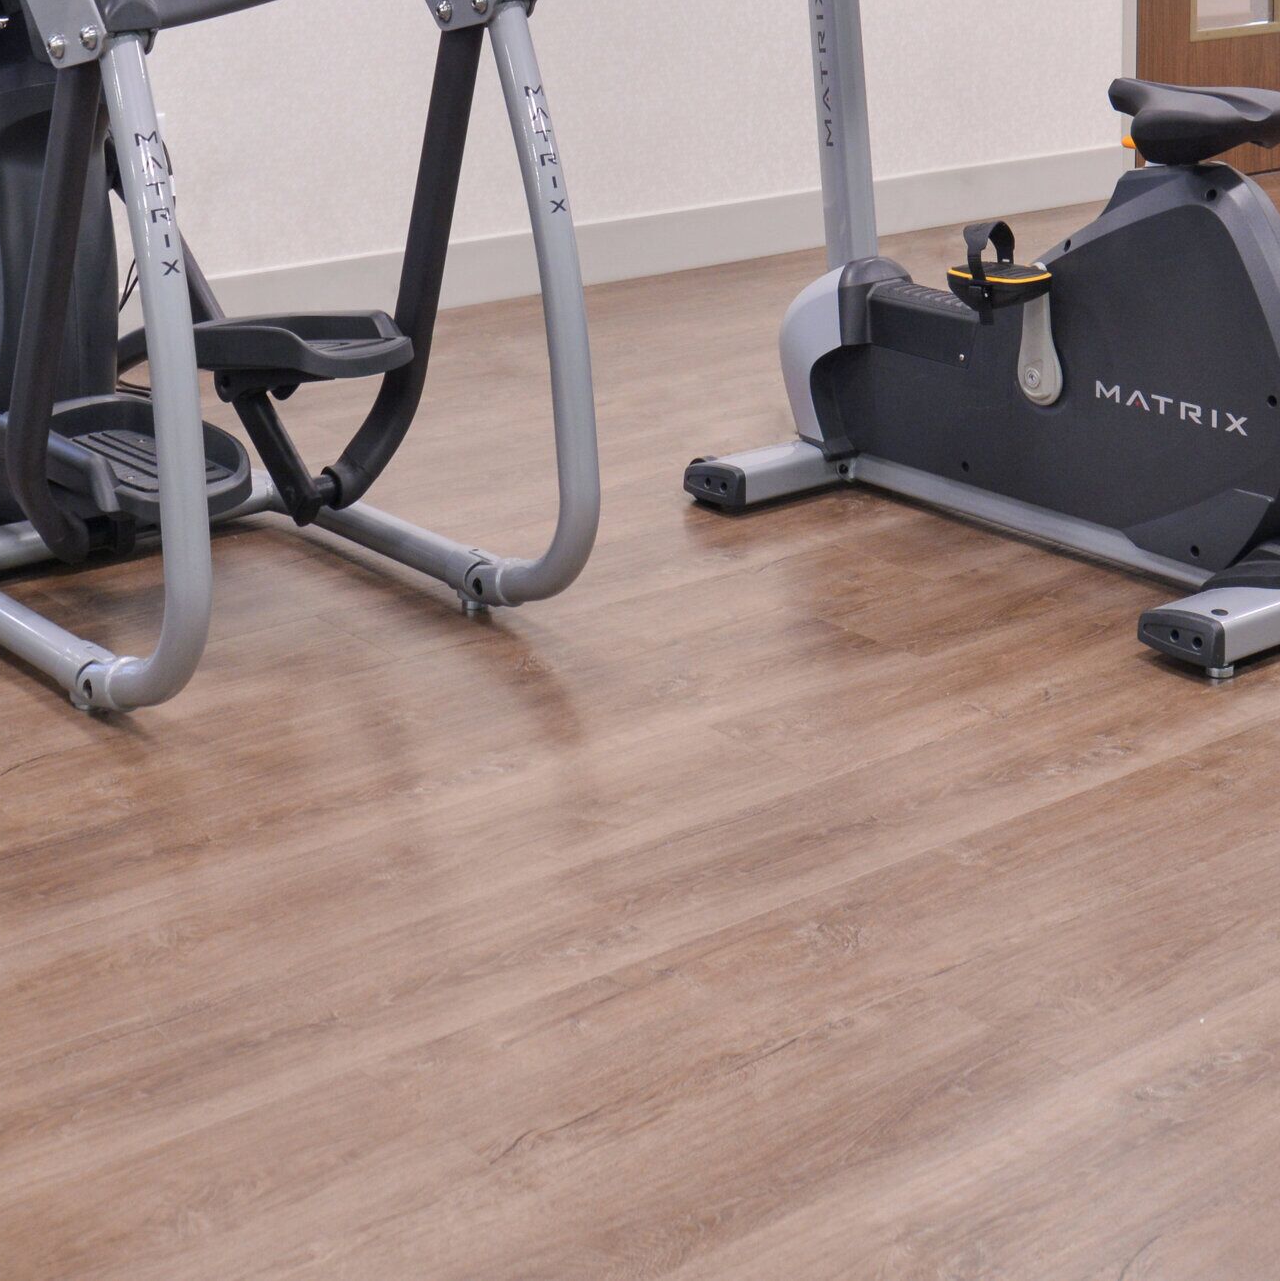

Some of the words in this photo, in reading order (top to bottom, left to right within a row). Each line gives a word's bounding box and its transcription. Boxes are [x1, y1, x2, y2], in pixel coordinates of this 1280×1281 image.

[134, 130, 180, 276] MATRIX
[524, 85, 566, 213] MATRIX
[1095, 380, 1248, 436] MATRIX
